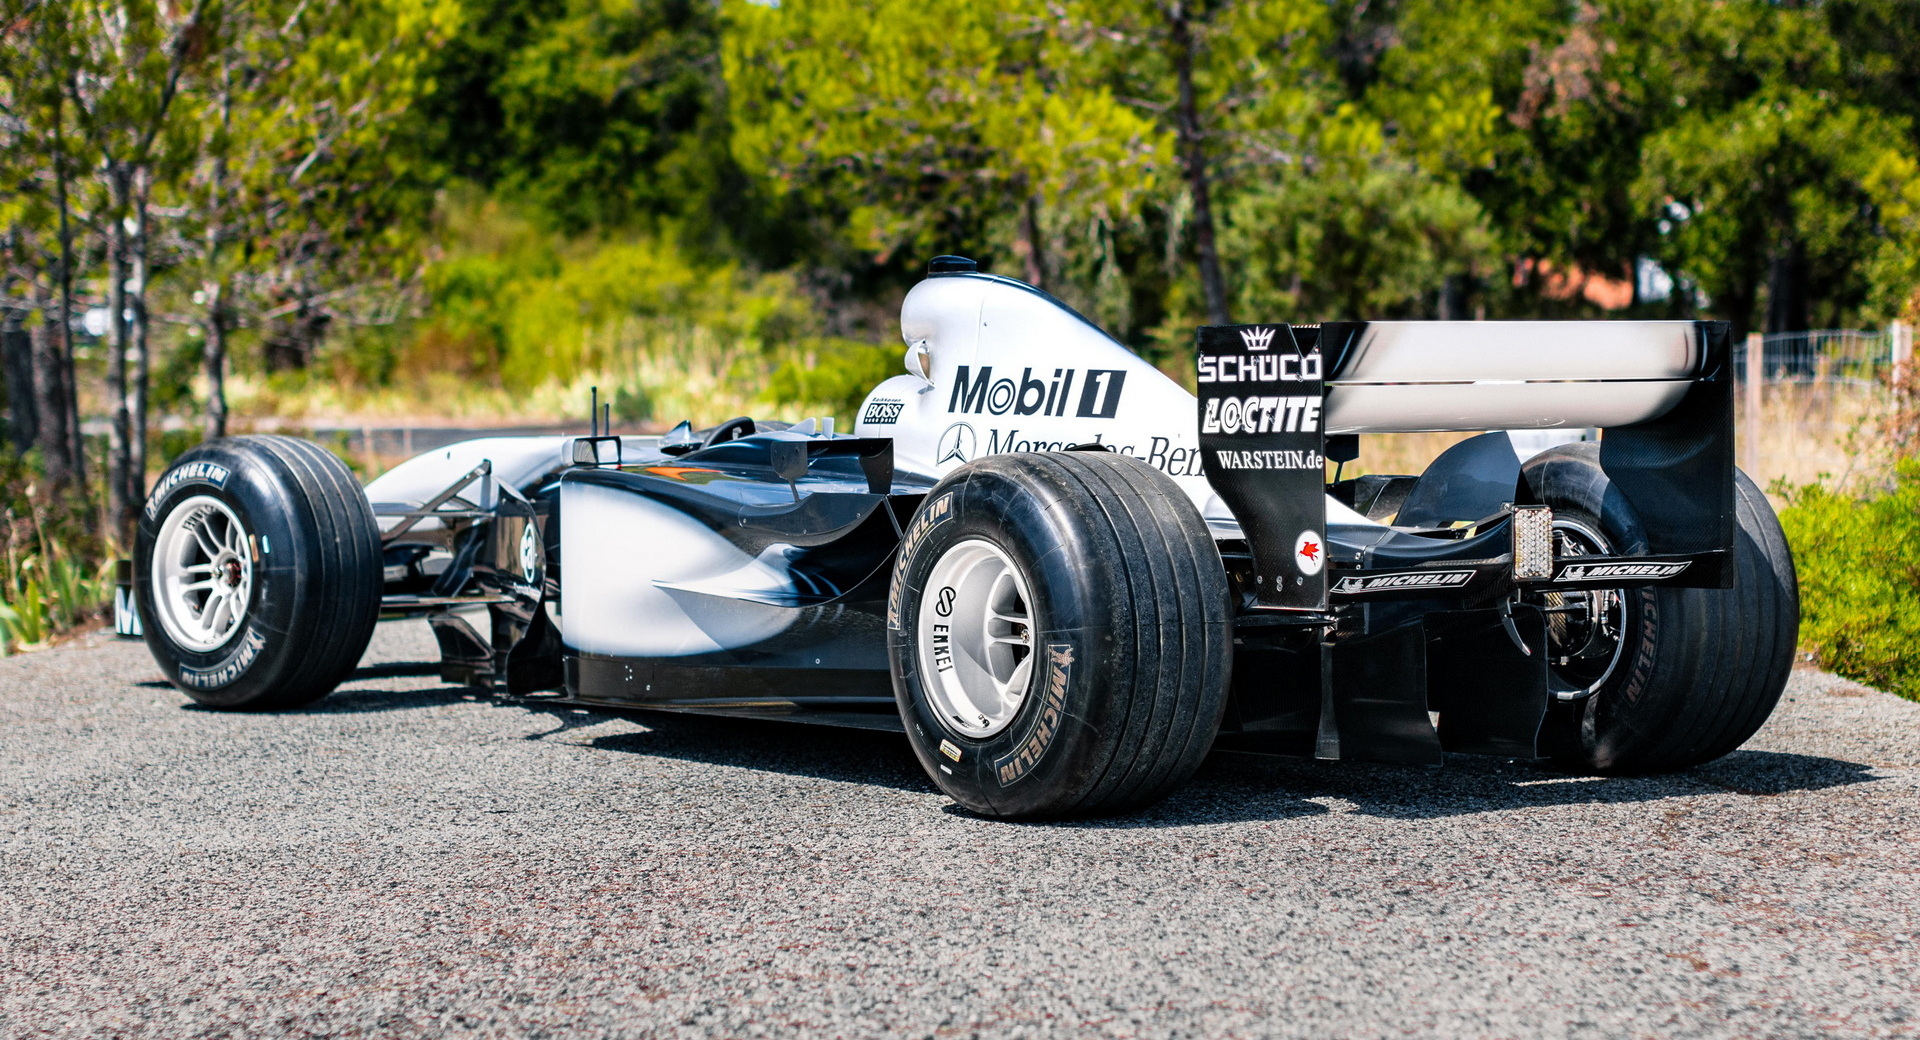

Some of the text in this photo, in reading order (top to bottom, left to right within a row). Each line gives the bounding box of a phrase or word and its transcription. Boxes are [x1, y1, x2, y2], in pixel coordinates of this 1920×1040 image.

[1198, 353, 1322, 382] SCHÜCO
[866, 404, 902, 418] BOSS
[948, 365, 1075, 417] Mobil
[1202, 395, 1323, 434] LOCTITE
[1216, 450, 1323, 469] WARSTEIN.de
[154, 463, 228, 506] MICHELIN
[890, 496, 950, 607] MICHELIN
[1587, 564, 1685, 576] MICHELIN
[1366, 570, 1468, 587] MICHELIN
[181, 641, 254, 687] MICHELIN
[933, 624, 953, 673] ENKEI
[1000, 665, 1067, 784] MICHELIN
